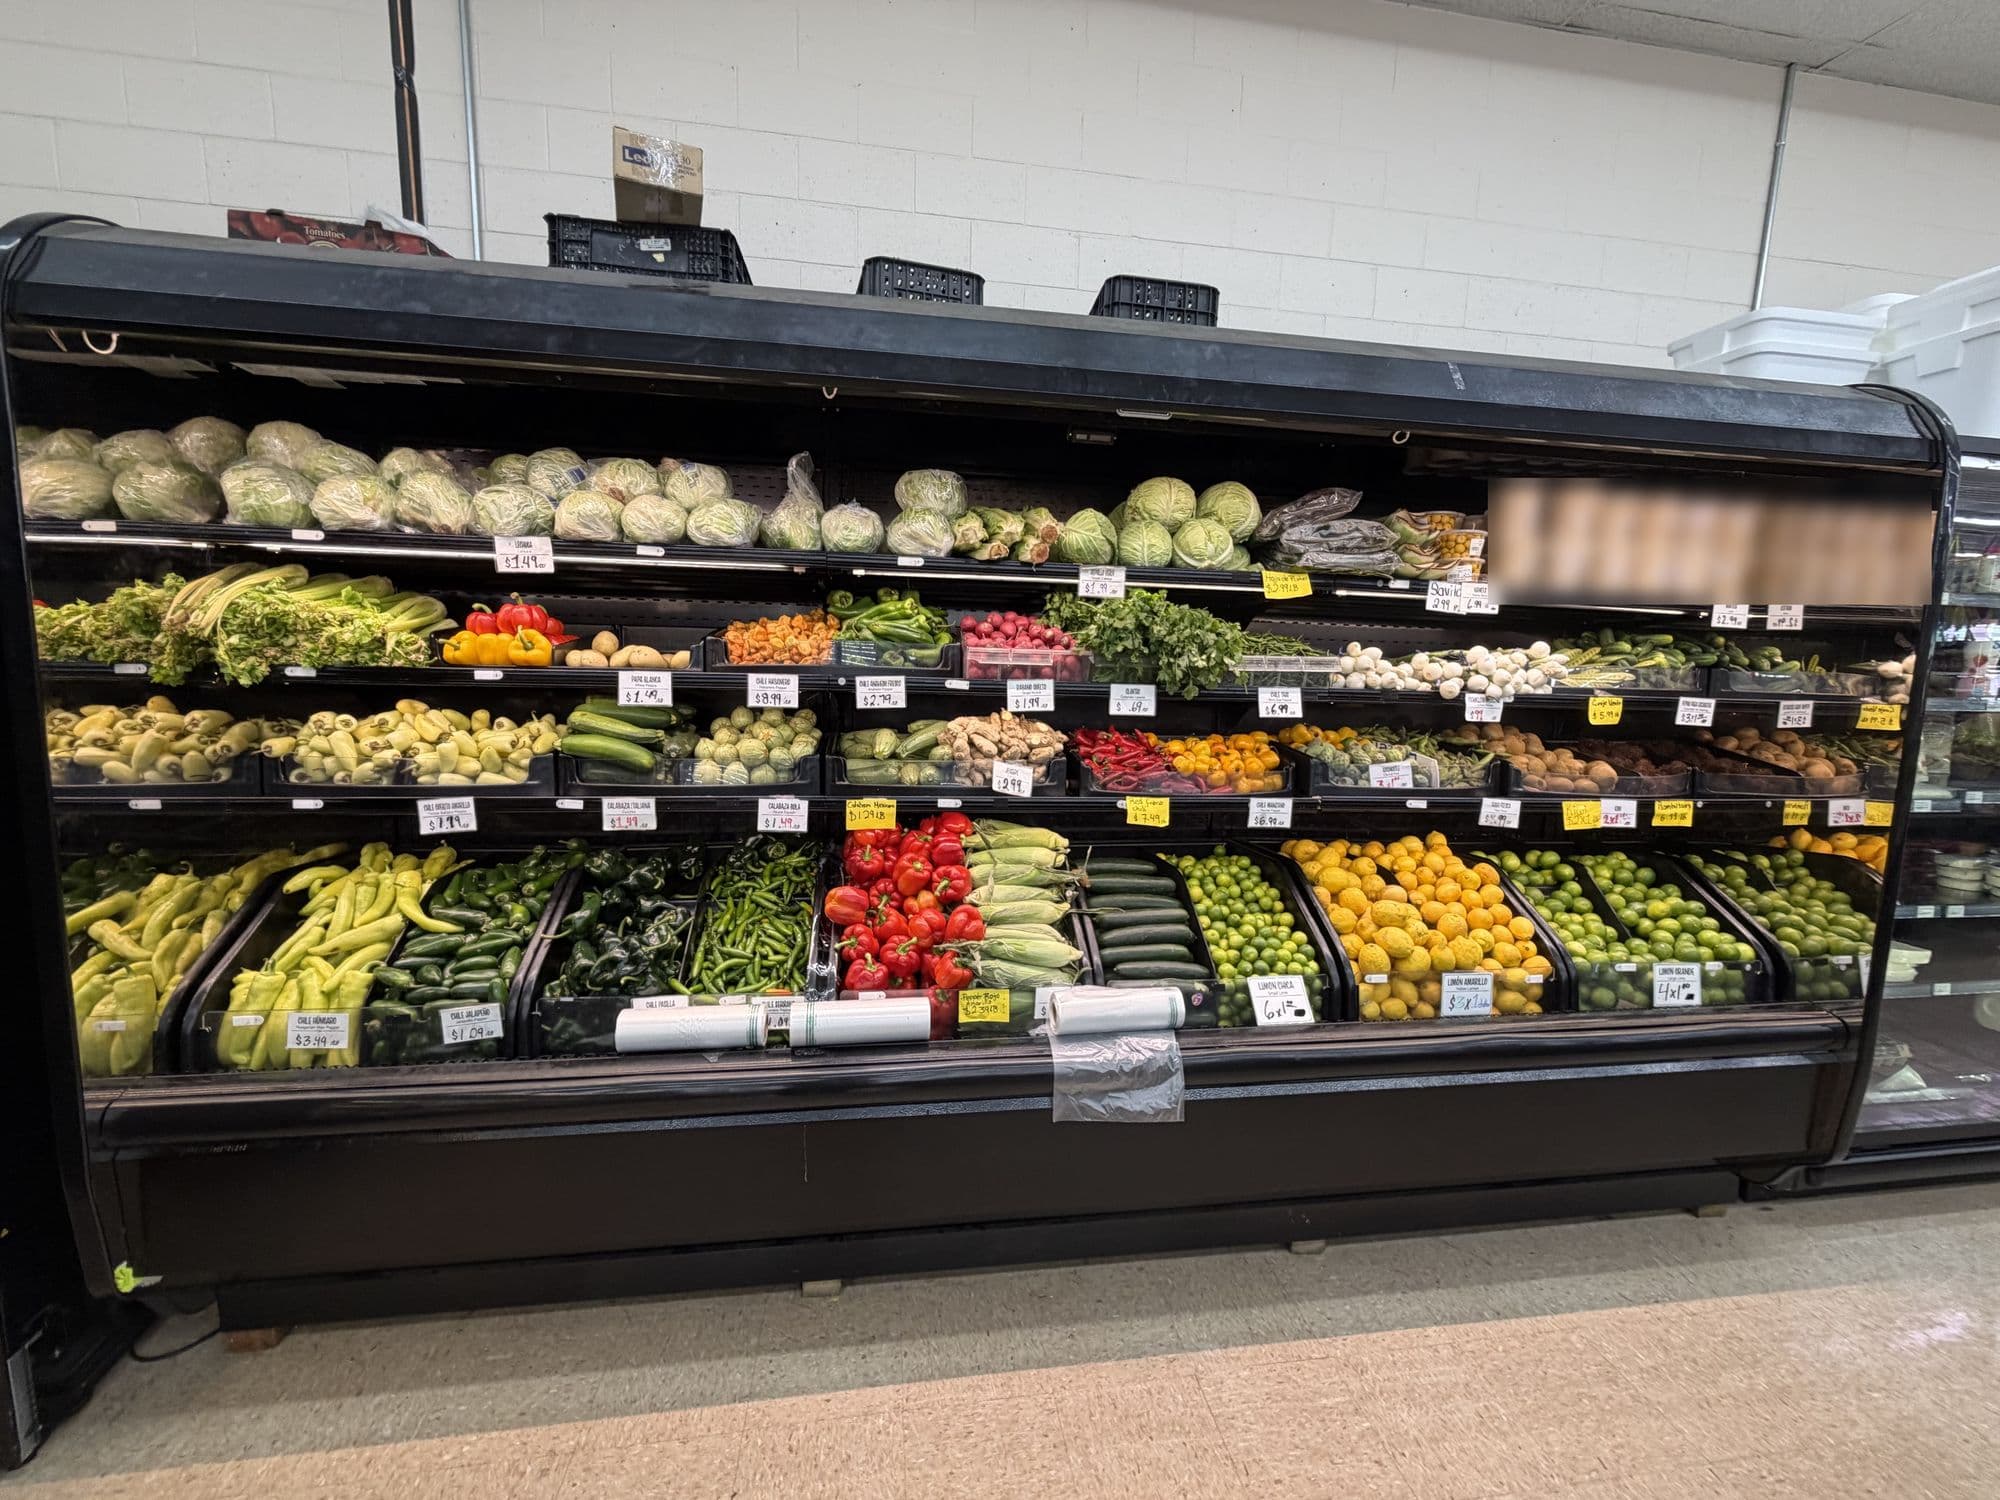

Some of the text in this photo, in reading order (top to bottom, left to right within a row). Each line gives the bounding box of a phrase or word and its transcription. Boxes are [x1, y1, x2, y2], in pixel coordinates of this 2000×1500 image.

[304, 225, 345, 239] Tomatoes
[1464, 977, 1488, 986] AMARILLO
[645, 1000, 675, 1009] CHILE PASILLA
[450, 1010, 465, 1020] CHILE
[297, 1016, 311, 1024] CHILE
[296, 1034, 327, 1047] $3.49
